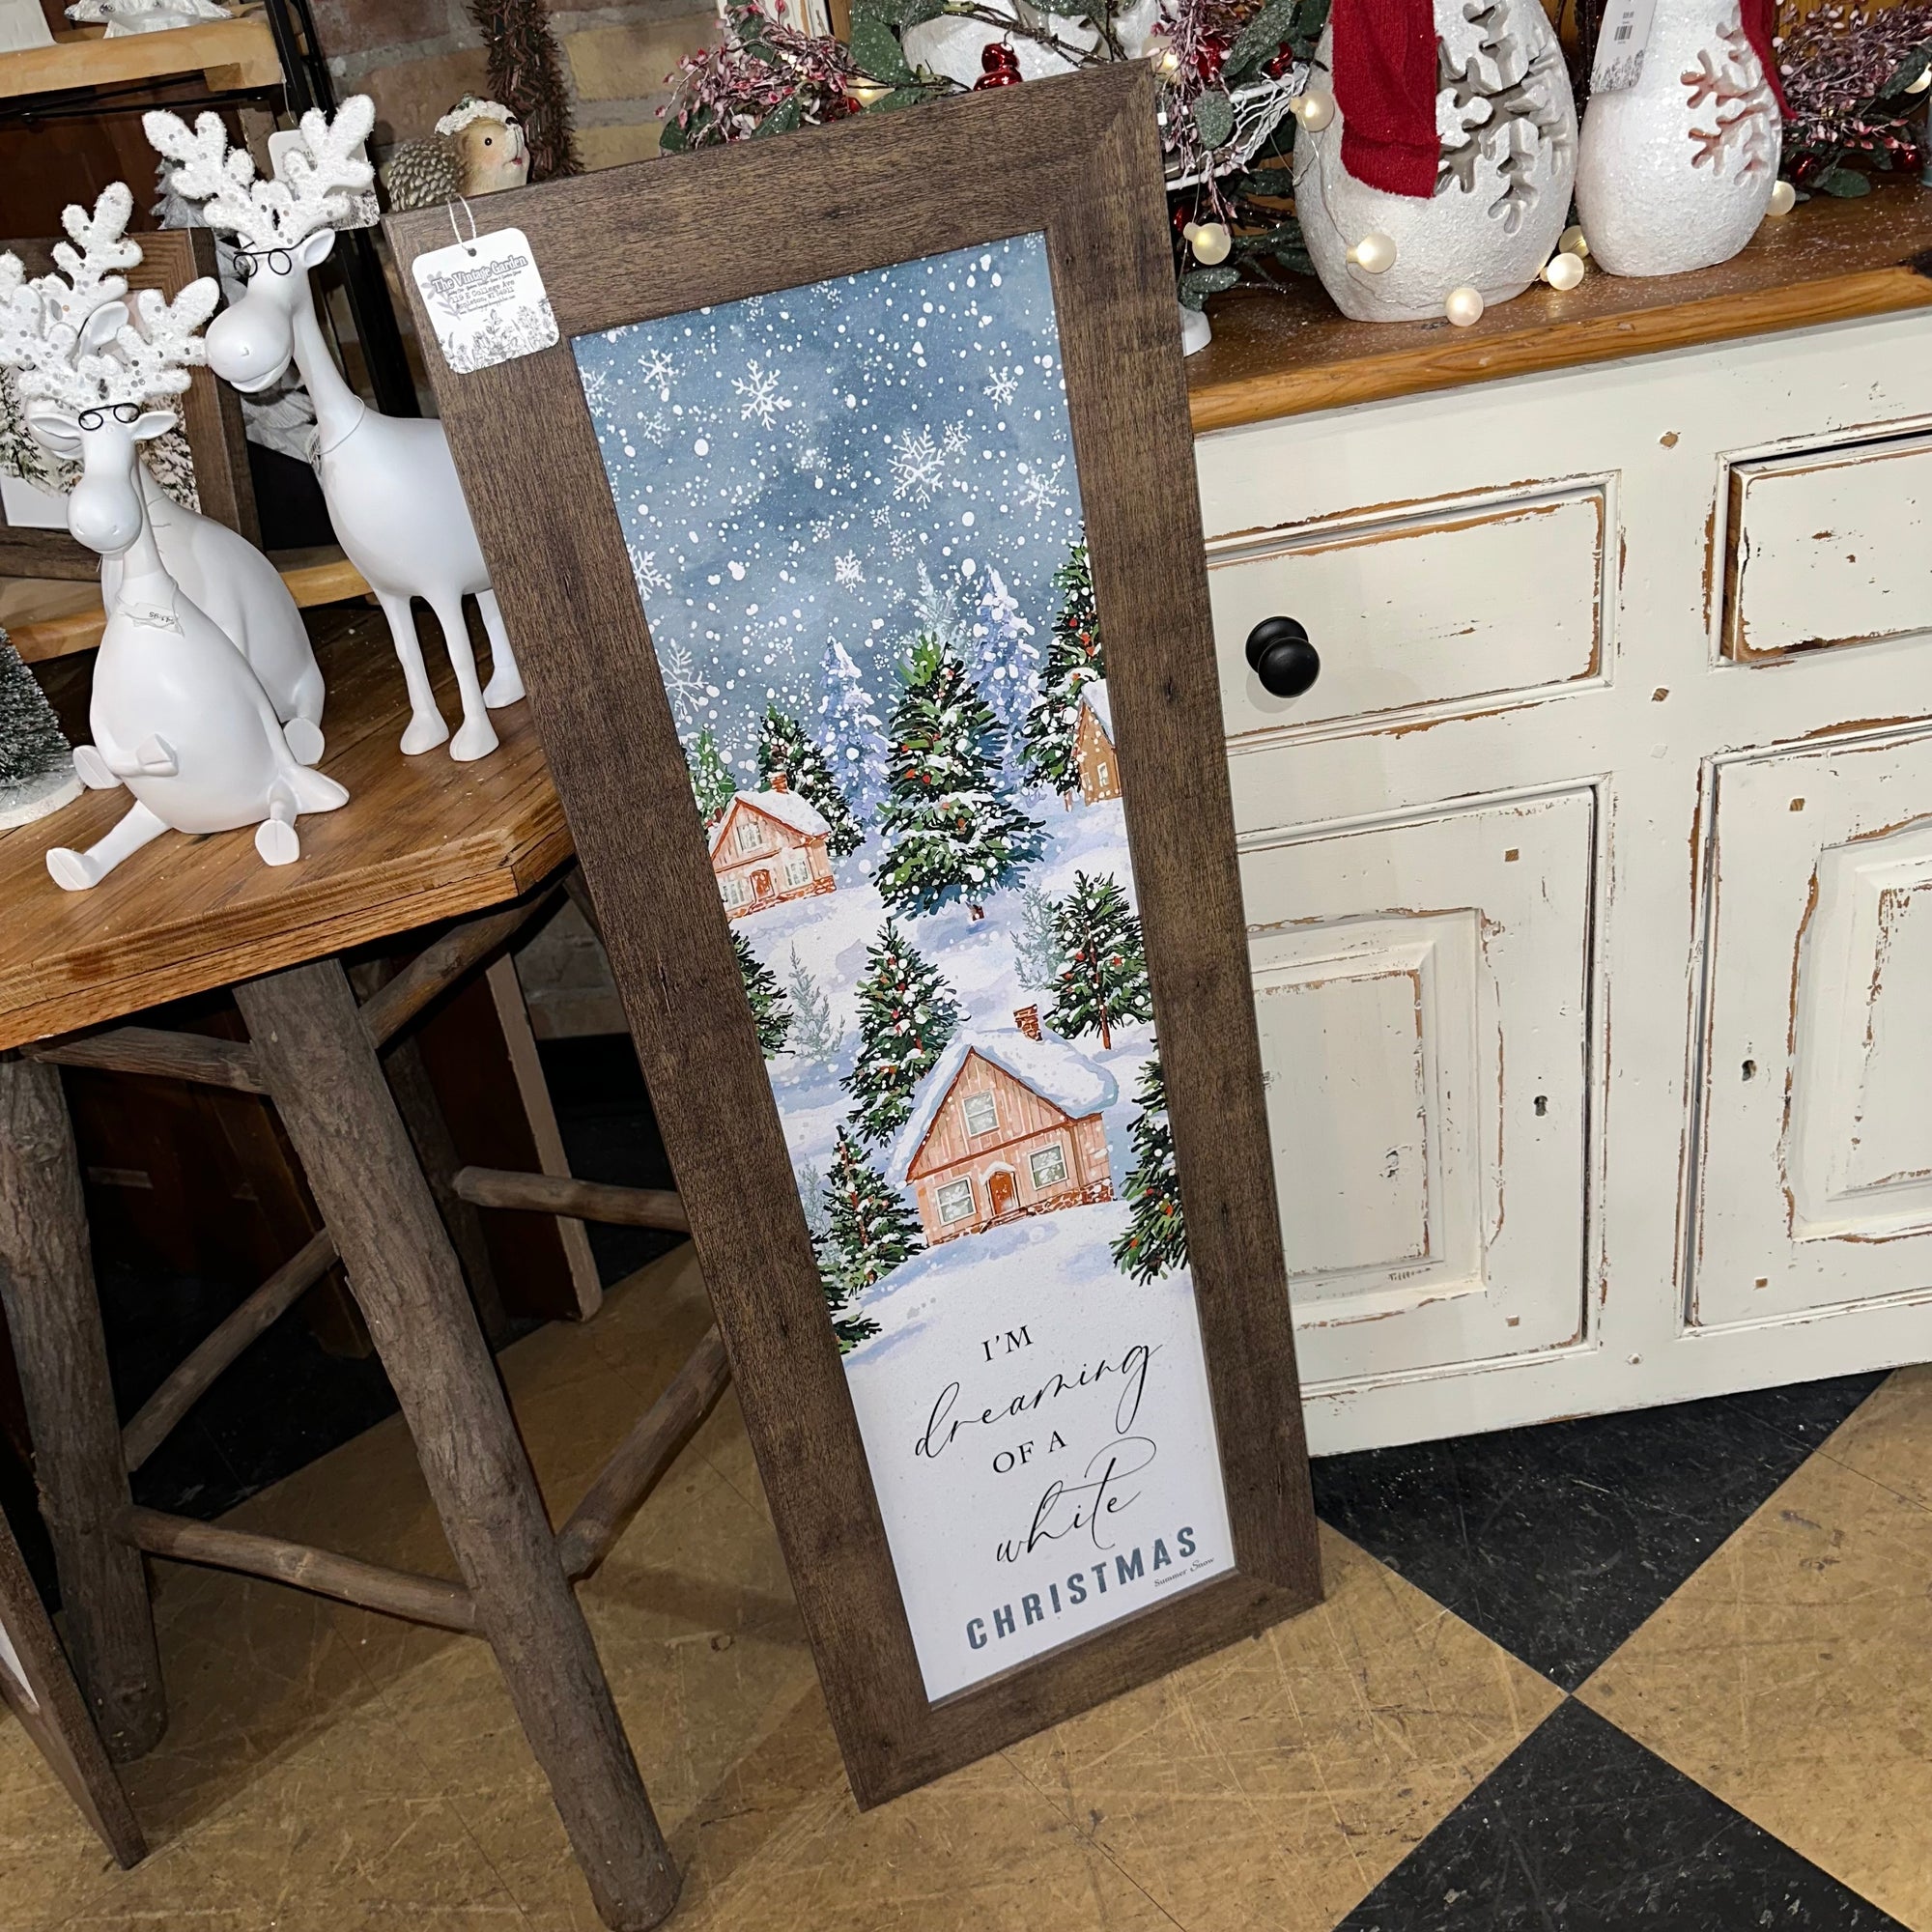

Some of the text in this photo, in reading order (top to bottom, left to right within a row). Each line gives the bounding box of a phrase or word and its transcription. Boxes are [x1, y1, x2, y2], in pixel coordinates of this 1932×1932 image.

[432, 276, 454, 294] The
[451, 266, 491, 287] Vintage
[490, 254, 528, 274] Garden
[471, 285, 501, 298] College
[502, 279, 515, 288] Ave
[980, 1324, 1035, 1362] I'M
[914, 1343, 1163, 1460] dreaming
[992, 1430, 1069, 1475] OF A
[996, 1436, 1157, 1563] white
[966, 1526, 1197, 1650] CHRISTMAS
[1153, 1555, 1215, 1588] Summer Snow
